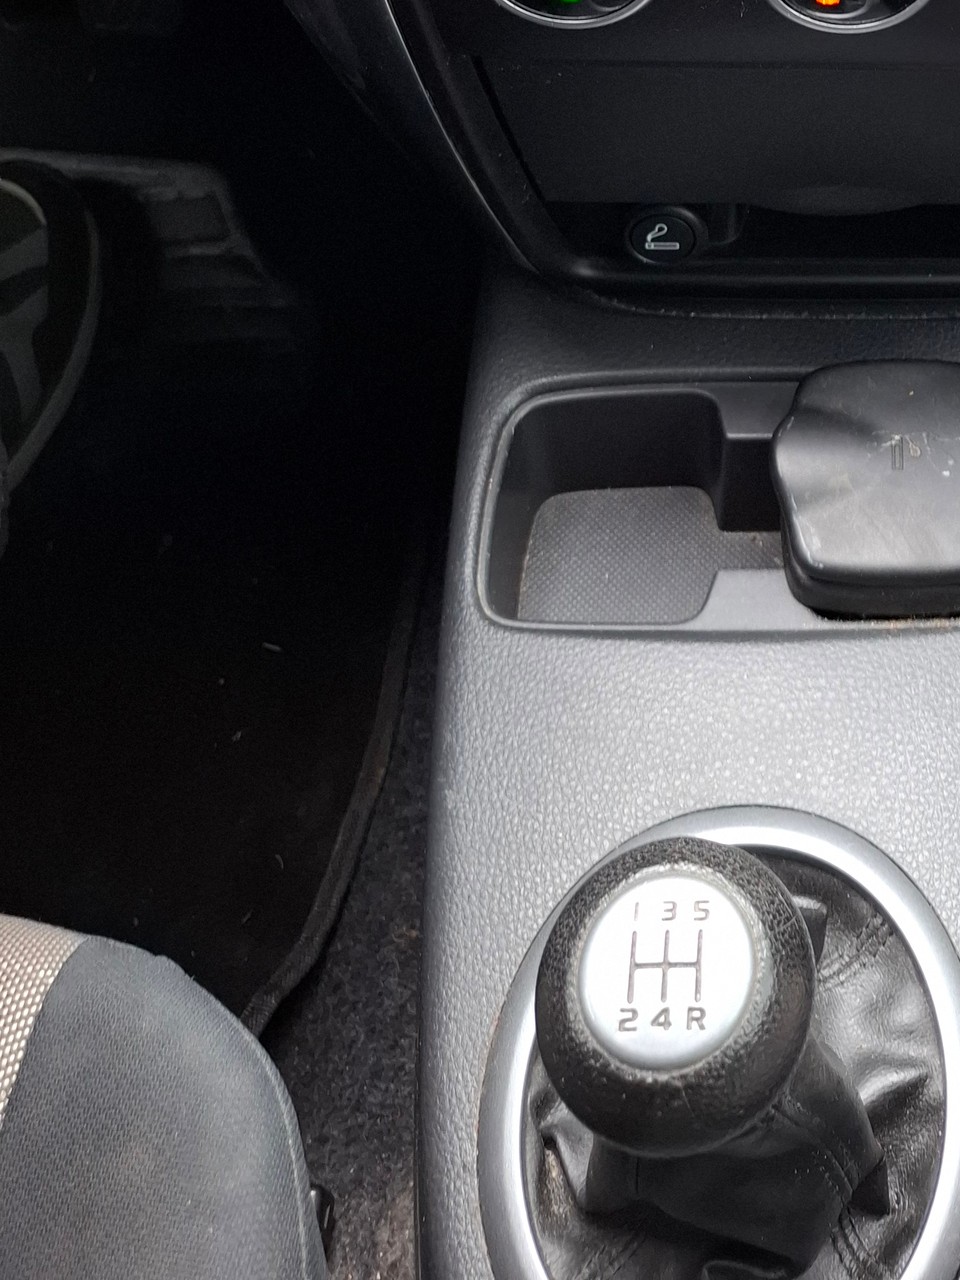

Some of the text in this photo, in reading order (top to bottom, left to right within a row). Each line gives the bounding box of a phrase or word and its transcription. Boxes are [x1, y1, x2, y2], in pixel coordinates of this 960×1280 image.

[633, 899, 710, 922] 1 3 5
[617, 1006, 707, 1032] 2 4 R
